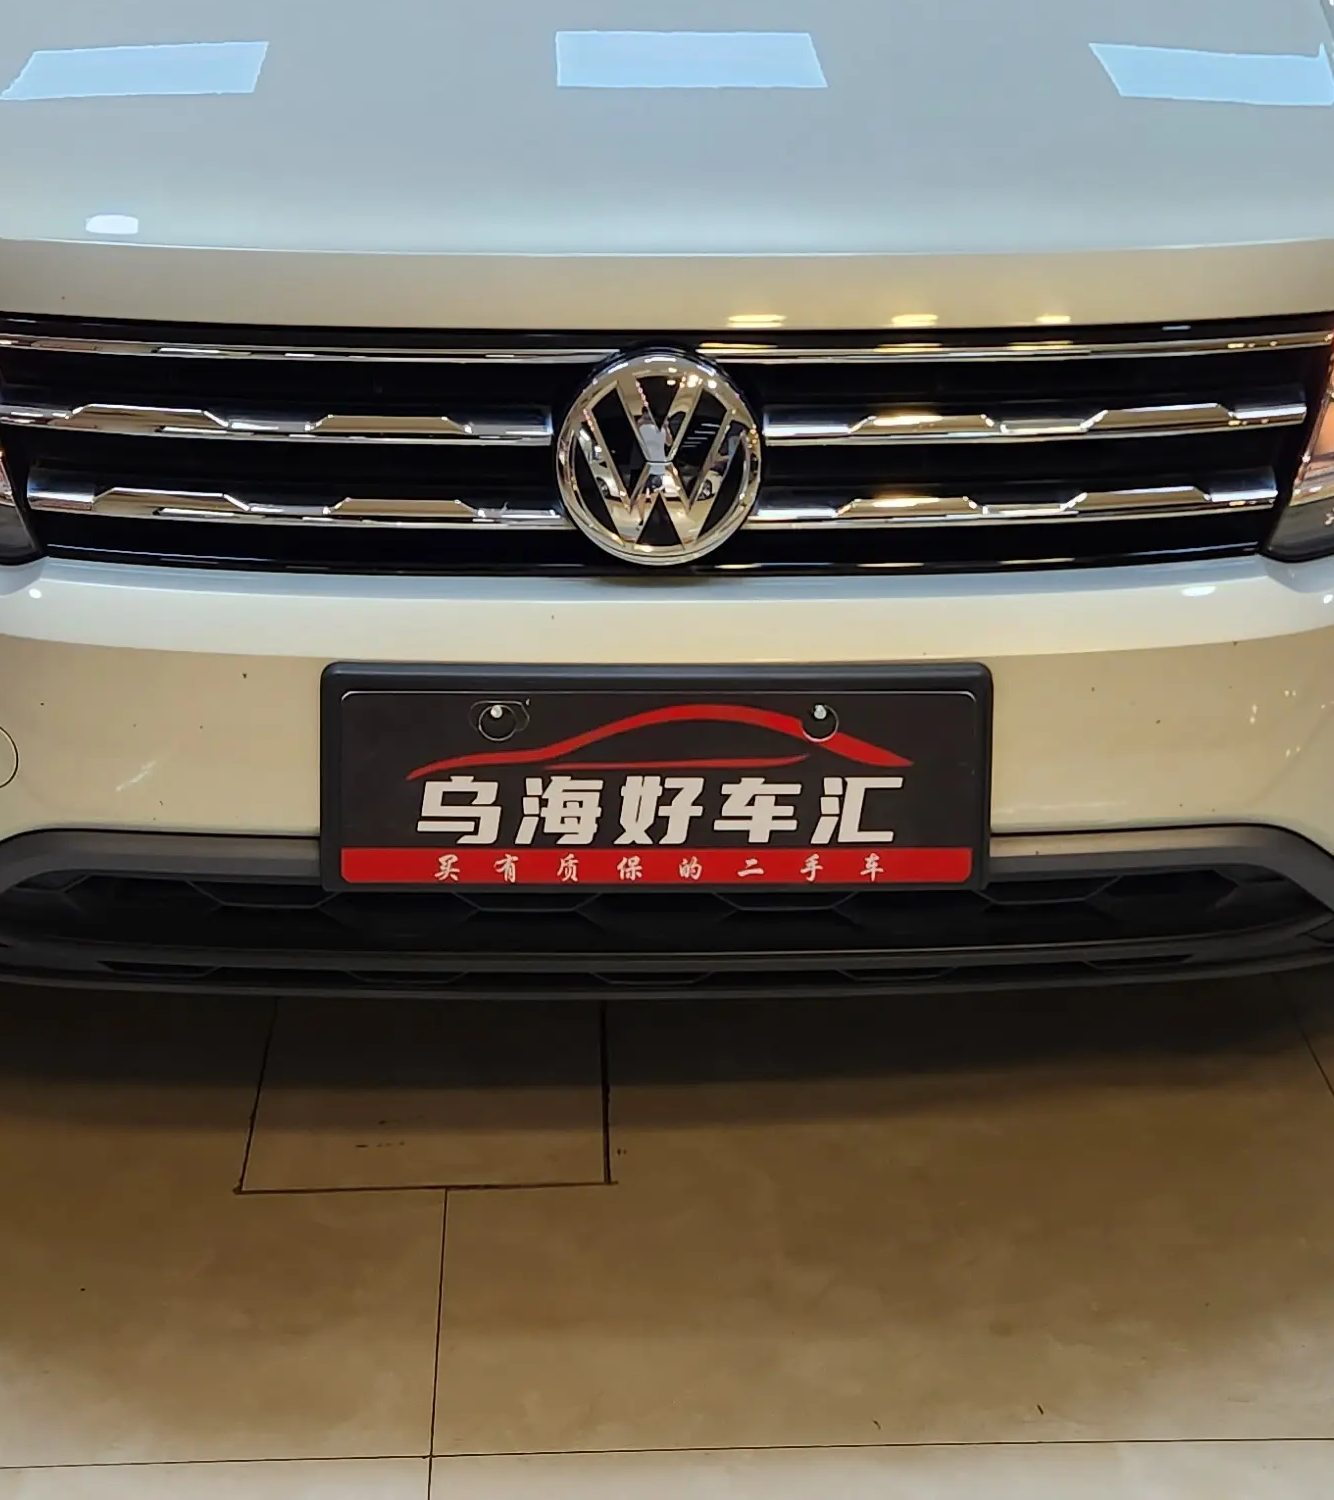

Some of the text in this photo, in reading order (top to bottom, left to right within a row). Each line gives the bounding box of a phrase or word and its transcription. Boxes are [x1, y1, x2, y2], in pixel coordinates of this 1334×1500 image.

[416, 775, 904, 845] 乌海好车汇
[433, 853, 886, 884] 买有质保的二手车
